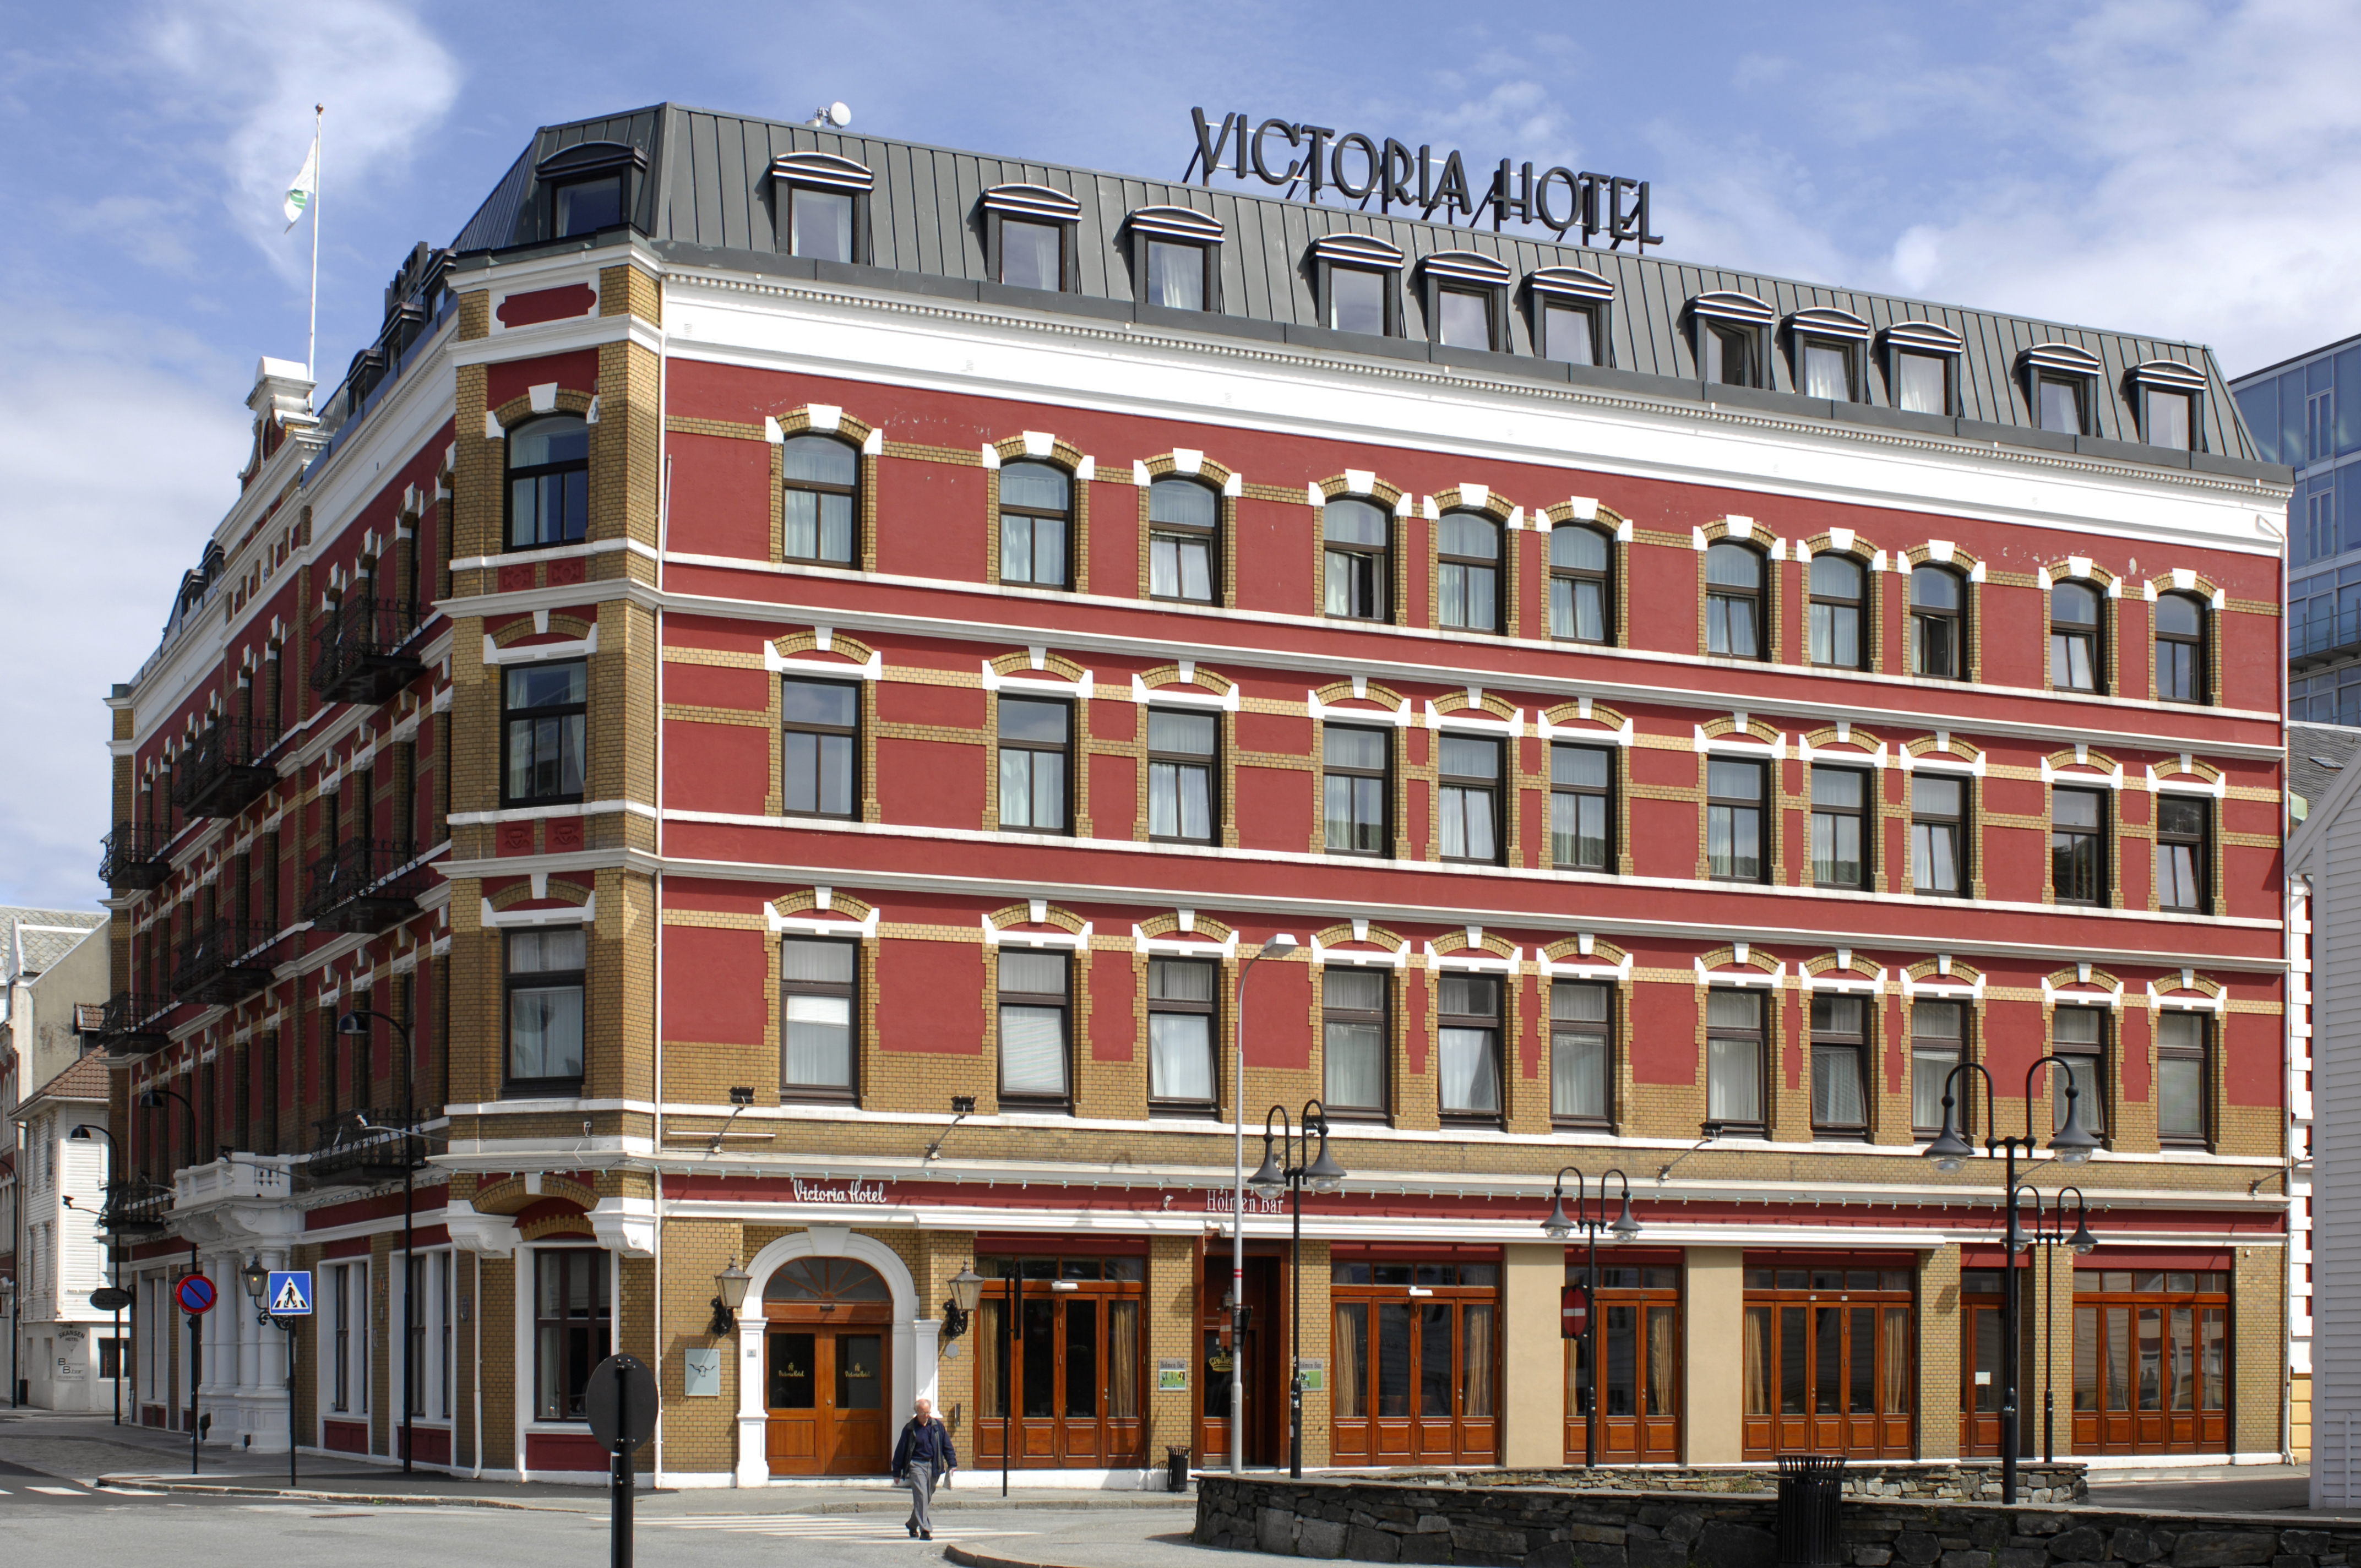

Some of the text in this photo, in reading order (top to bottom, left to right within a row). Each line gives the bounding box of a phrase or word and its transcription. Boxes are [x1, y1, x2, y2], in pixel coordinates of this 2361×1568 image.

[1190, 106, 1664, 246] VICTORIA HOTEL
[793, 1179, 887, 1204] Victoria Hotel
[1260, 1197, 1284, 1214] Bar
[58, 1330, 85, 1339] SKANSEN
